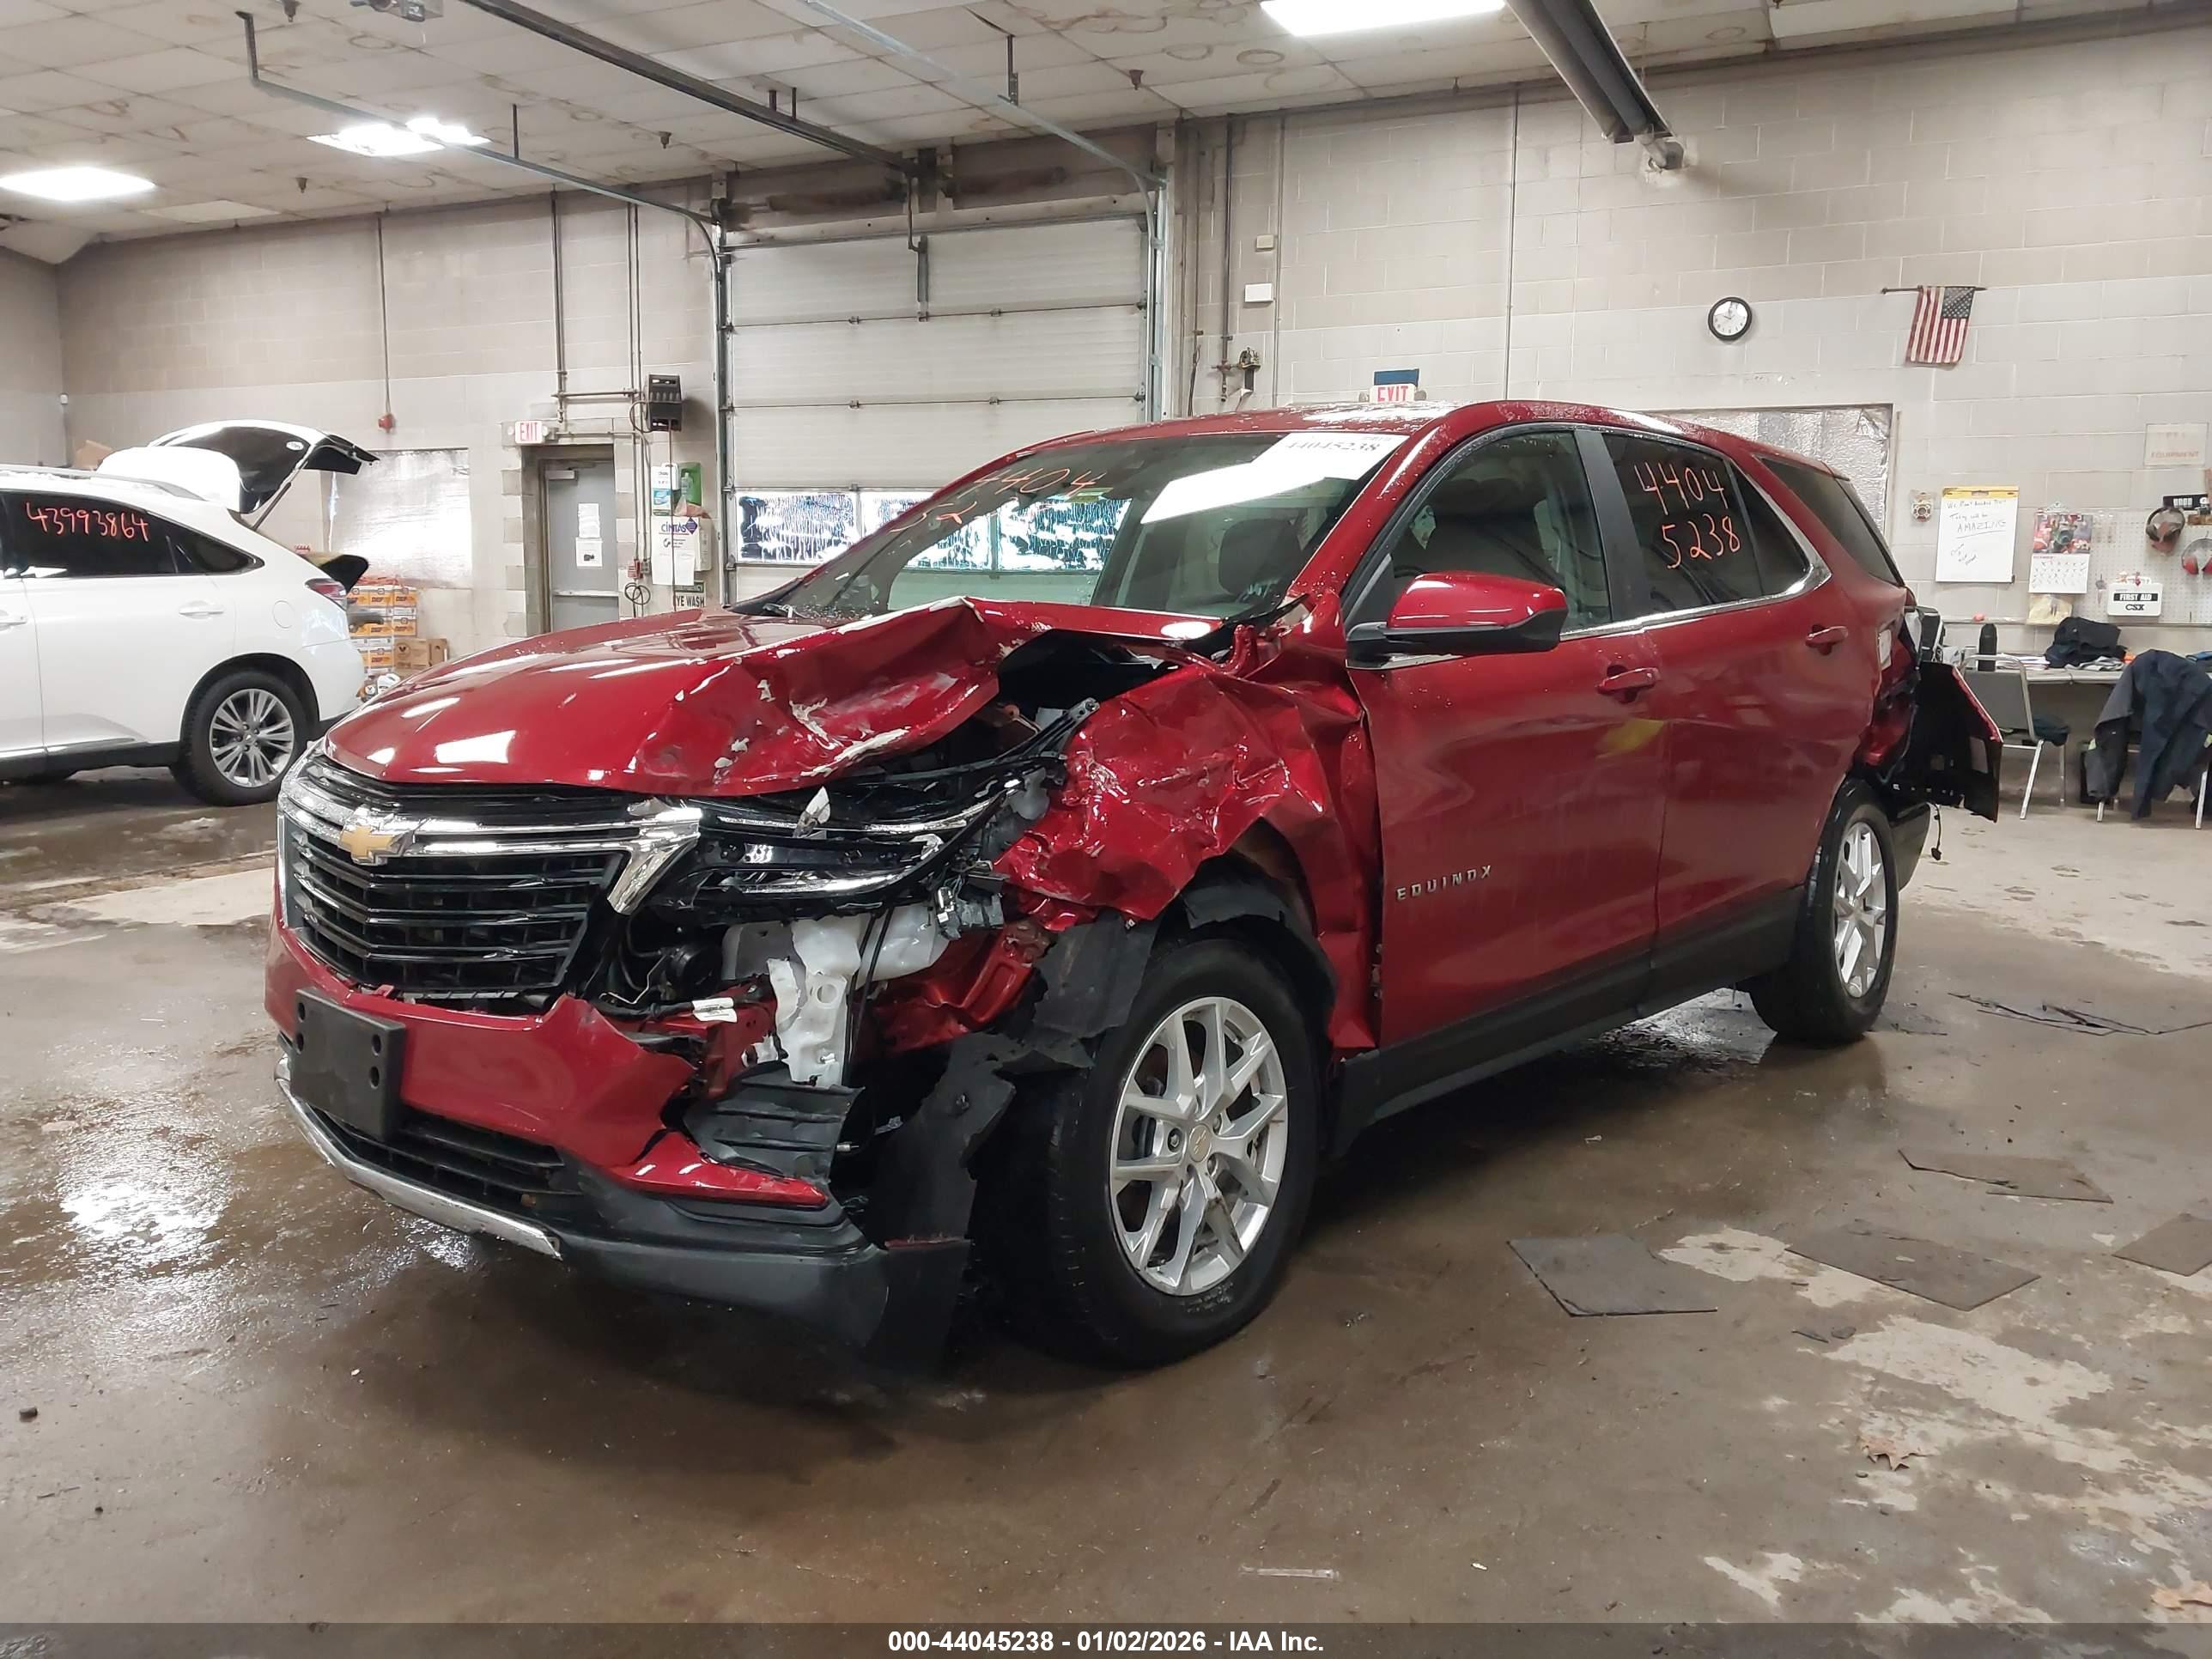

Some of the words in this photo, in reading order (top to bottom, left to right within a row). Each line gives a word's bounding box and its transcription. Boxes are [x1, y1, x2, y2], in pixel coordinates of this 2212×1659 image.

[520, 422, 538, 441] EXIT
[1634, 462, 1729, 515] 4404
[26, 502, 149, 542] 43993864
[1662, 514, 1741, 568] 5238
[686, 595, 705, 608] WASH
[1397, 865, 1492, 901] EQUINOX
